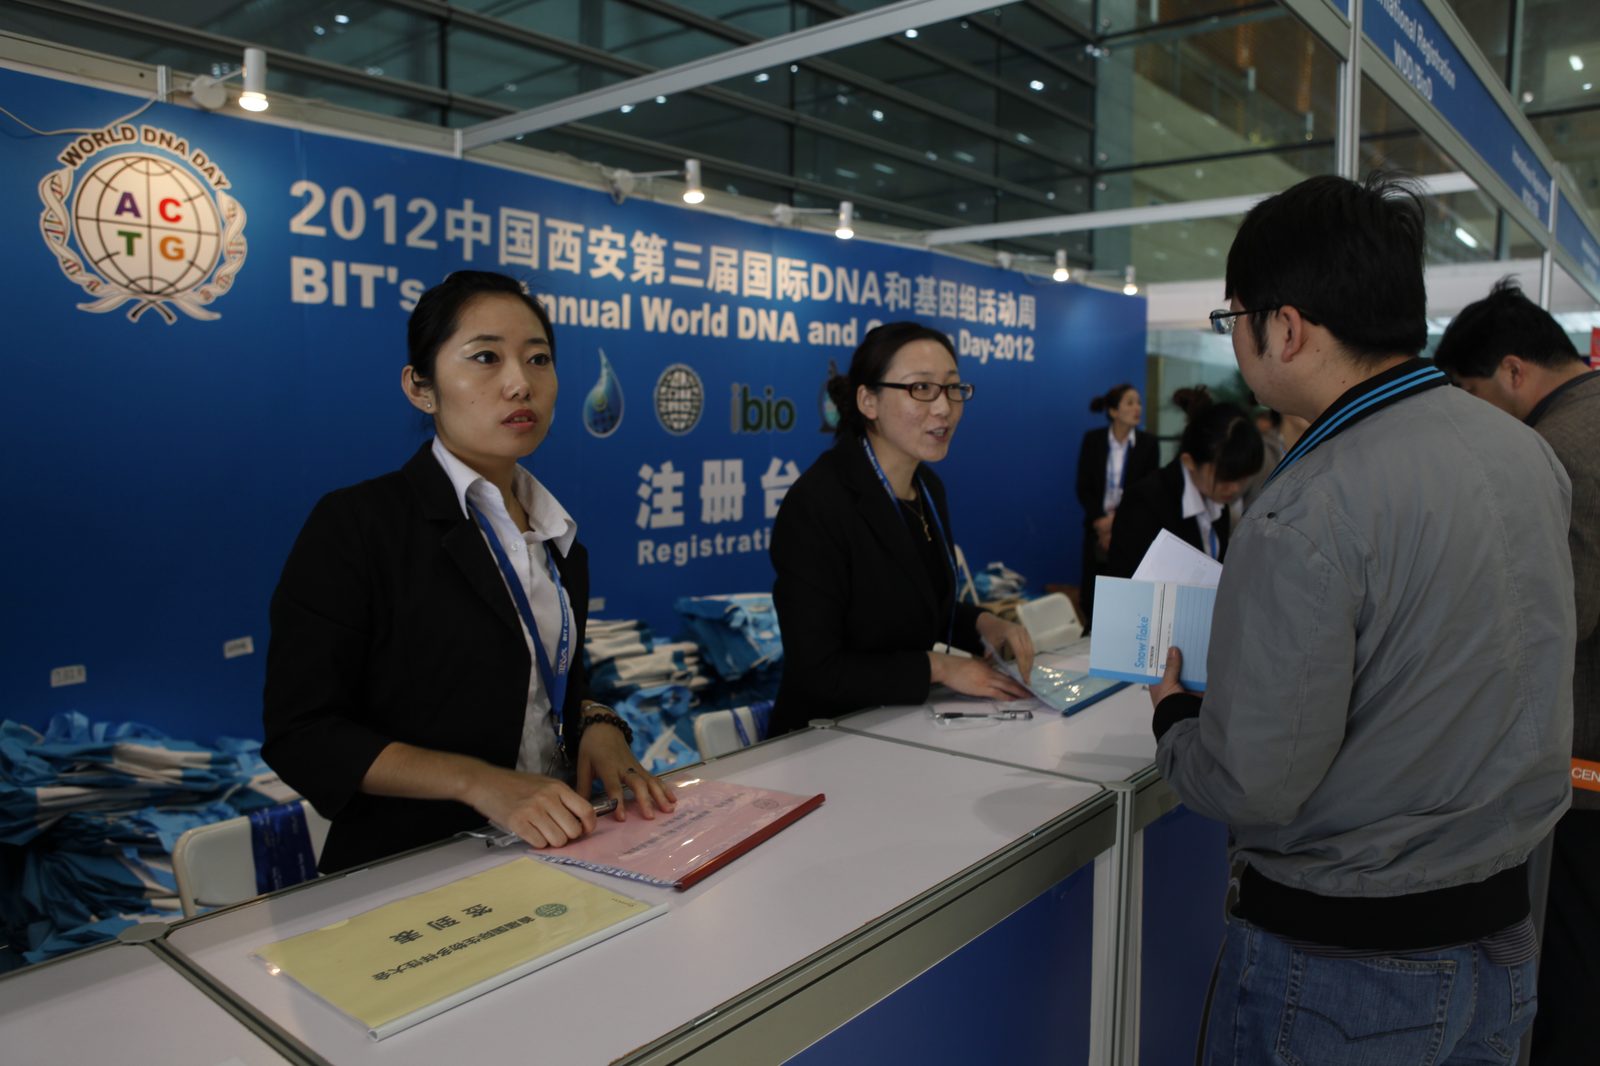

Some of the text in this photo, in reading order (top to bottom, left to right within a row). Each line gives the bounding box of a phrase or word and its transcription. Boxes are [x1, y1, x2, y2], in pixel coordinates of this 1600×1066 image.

[60, 124, 228, 188] WORLD DNA DAY
[290, 255, 1036, 365] BIT's nnual World DNA and Day-2012
[637, 526, 772, 567] Registrati
[1134, 615, 1149, 669] Snow flake
